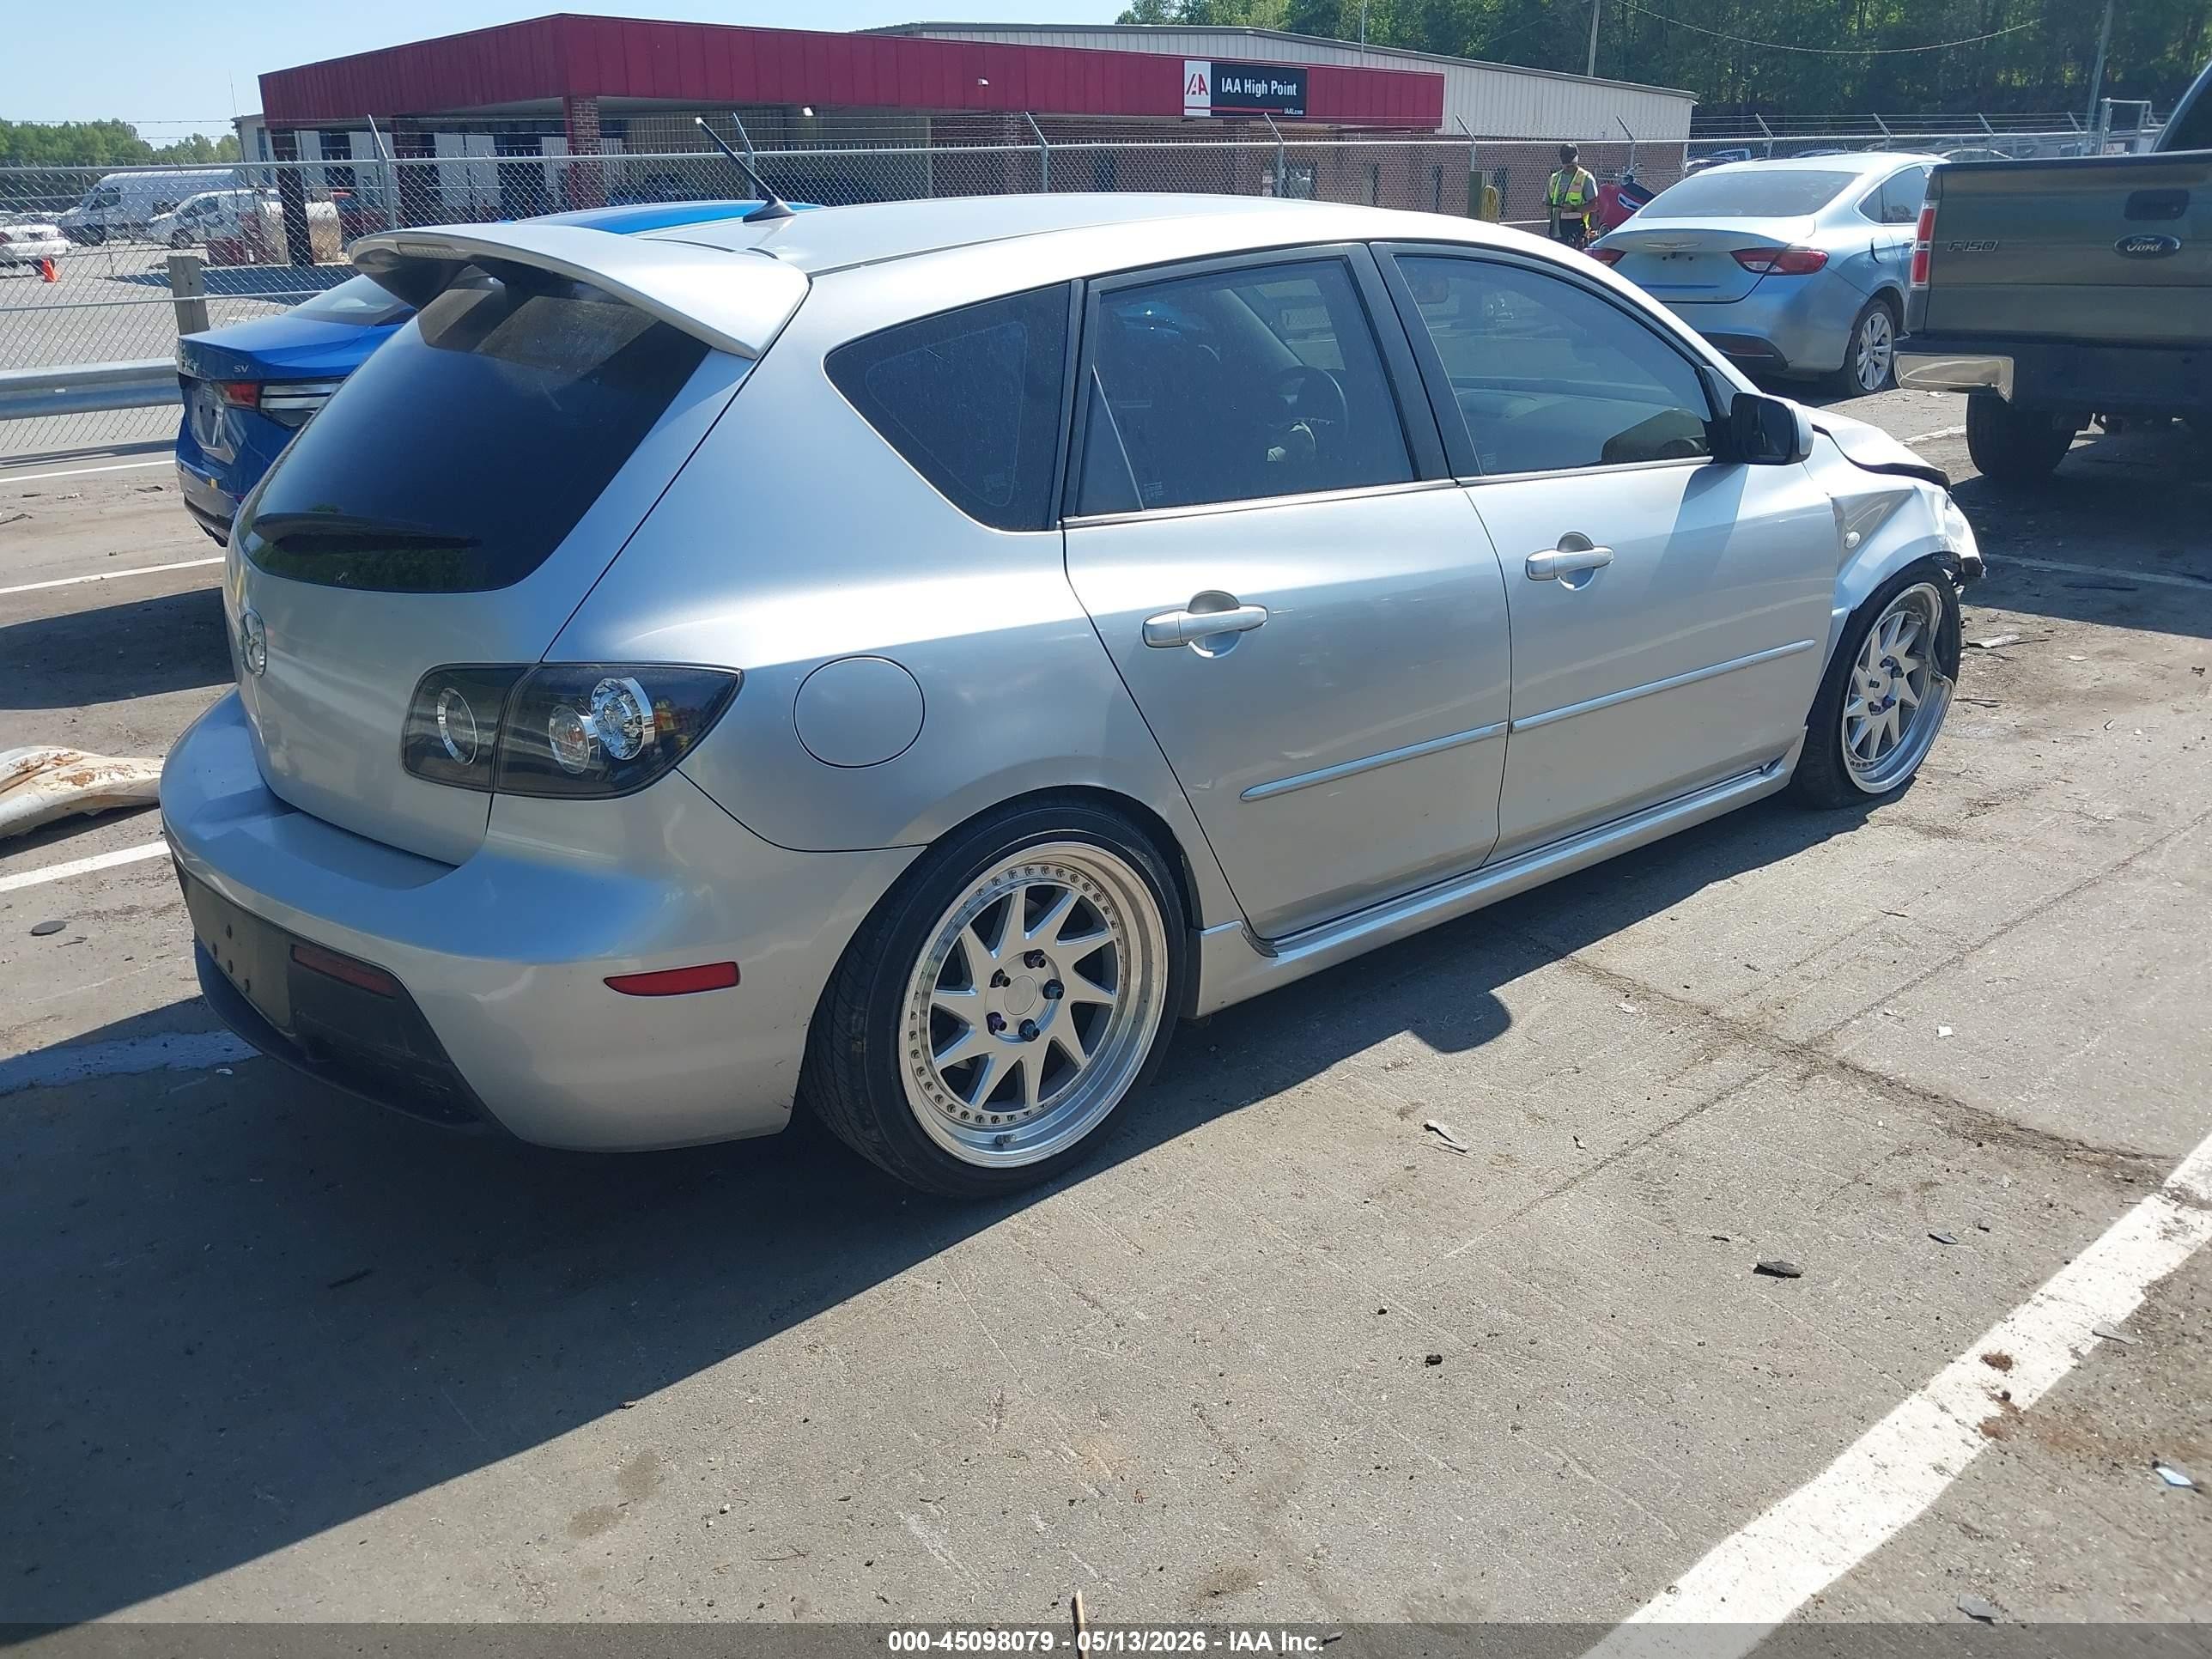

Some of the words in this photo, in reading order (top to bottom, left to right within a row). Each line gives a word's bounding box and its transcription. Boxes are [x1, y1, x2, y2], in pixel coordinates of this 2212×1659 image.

[1221, 77, 1242, 94] IAA
[1244, 78, 1268, 98] High
[1271, 80, 1297, 96] Point
[2126, 237, 2163, 252] Ford
[233, 364, 249, 373] SV
